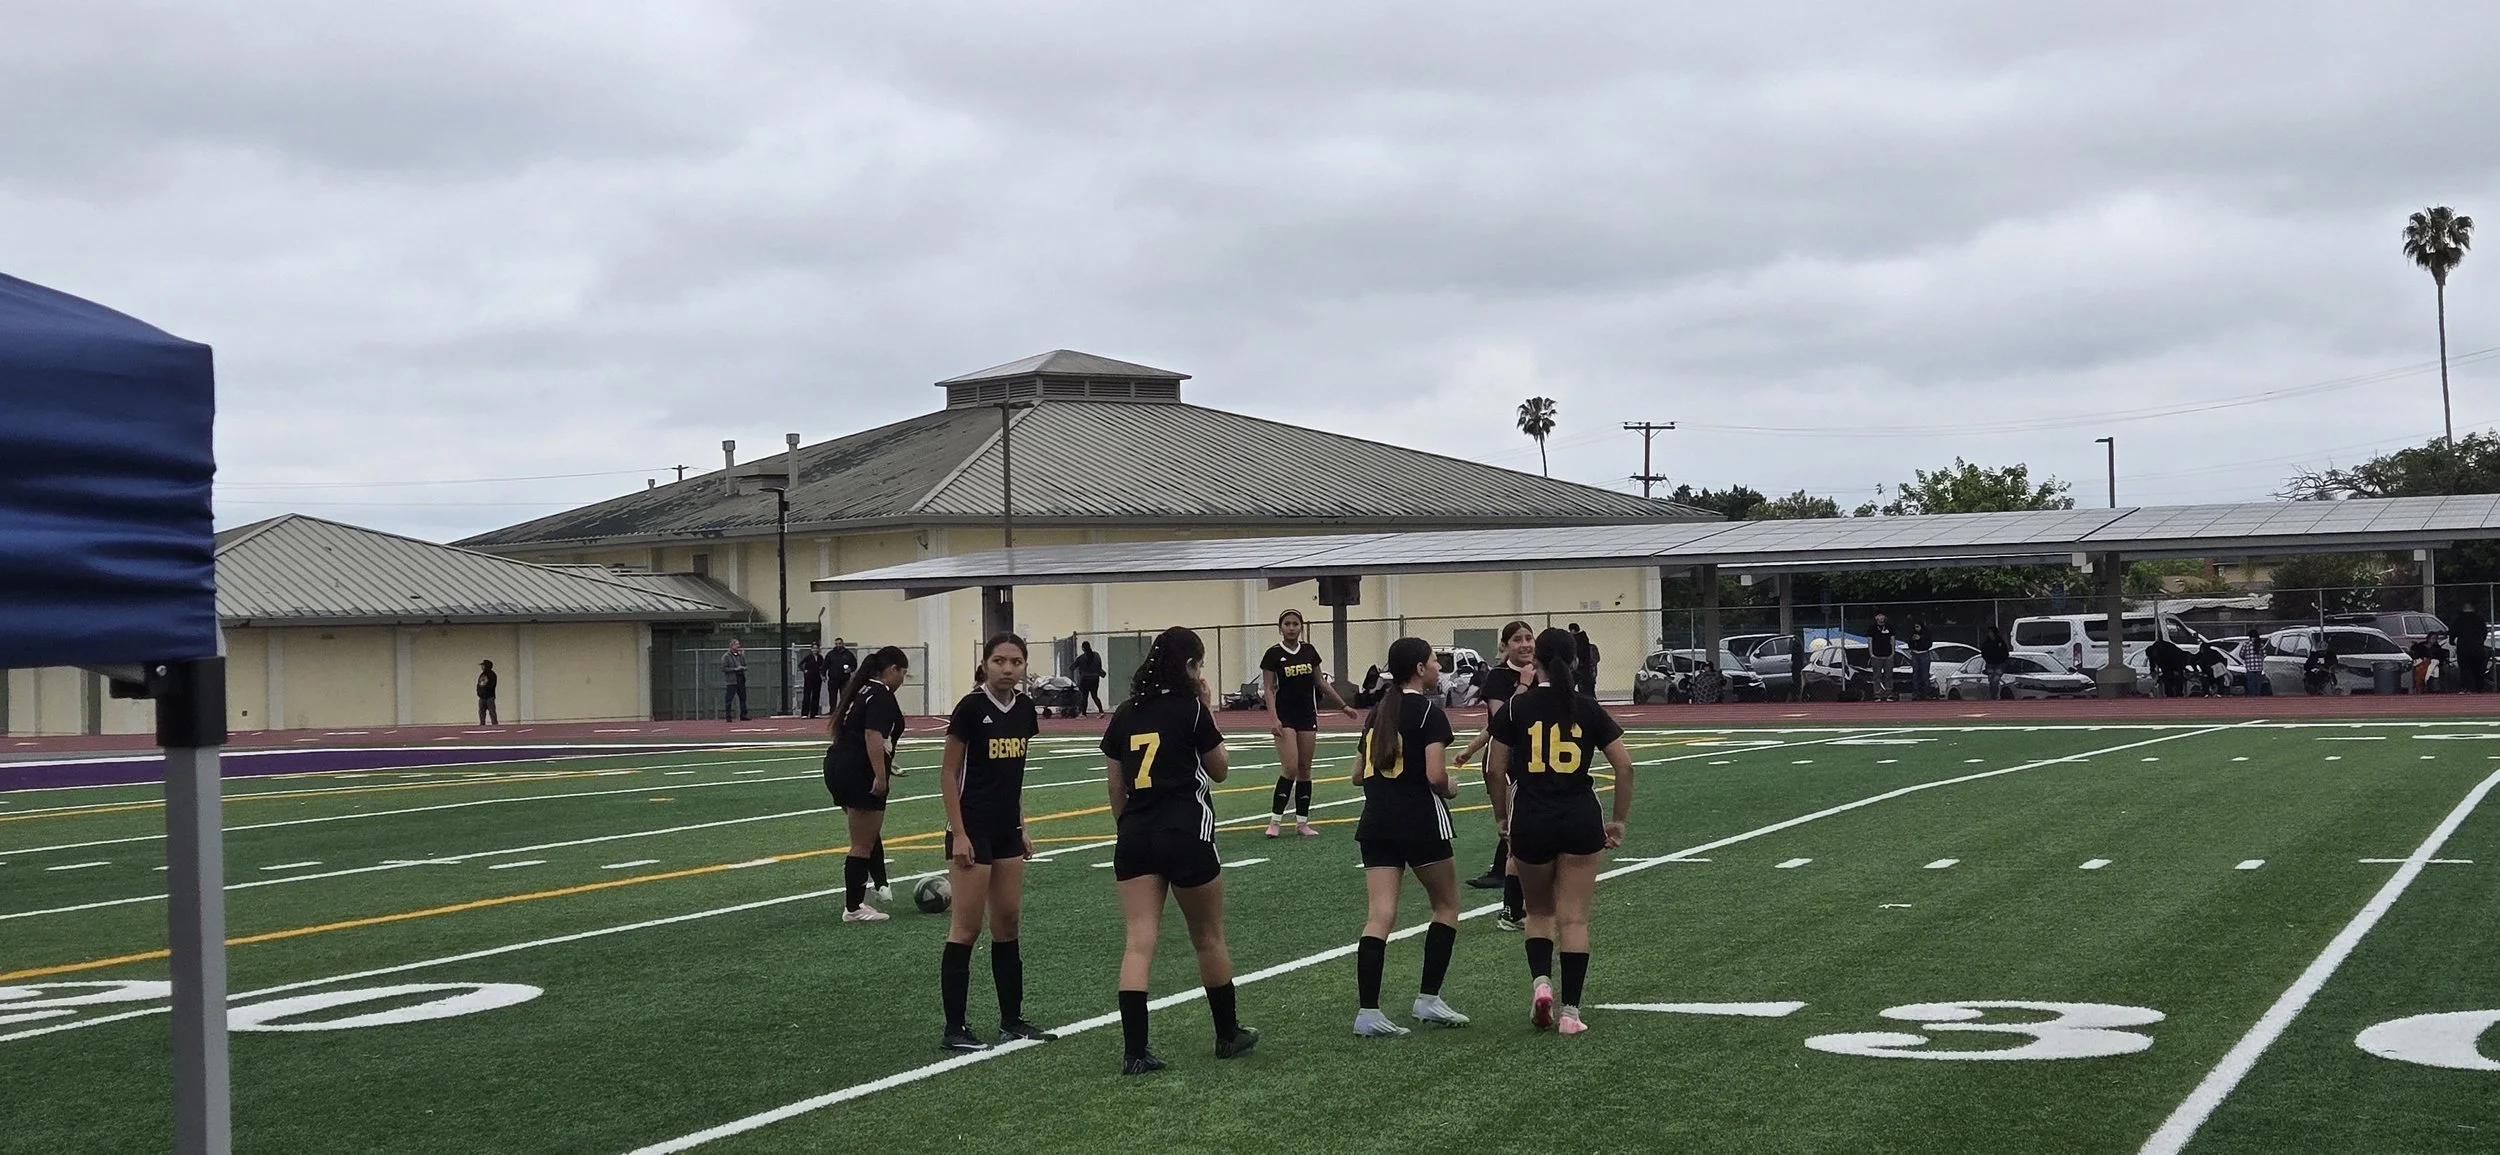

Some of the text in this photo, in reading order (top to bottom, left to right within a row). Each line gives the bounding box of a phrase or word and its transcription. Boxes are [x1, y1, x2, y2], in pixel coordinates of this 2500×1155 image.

[1284, 663, 1313, 678] BEARS
[988, 737, 1027, 760] BEARS
[1130, 731, 1161, 790] 7
[1527, 720, 1583, 774] 16
[1803, 1000, 2167, 1061] 3
